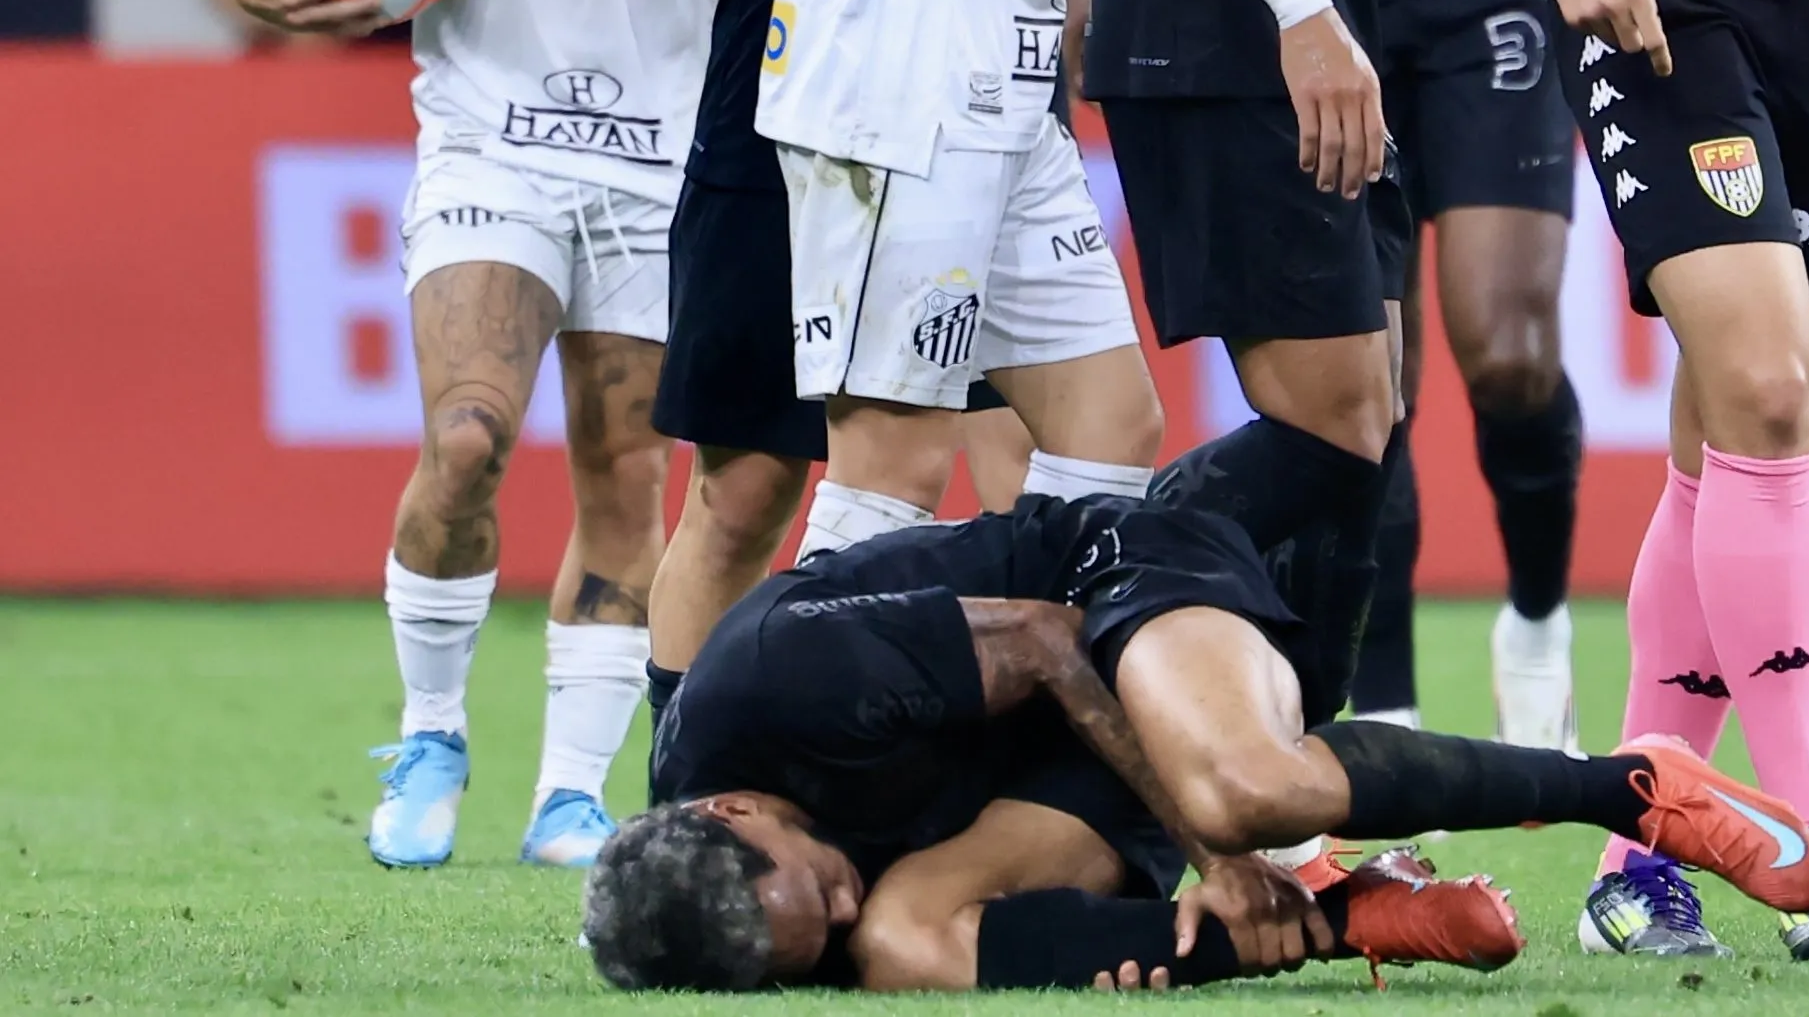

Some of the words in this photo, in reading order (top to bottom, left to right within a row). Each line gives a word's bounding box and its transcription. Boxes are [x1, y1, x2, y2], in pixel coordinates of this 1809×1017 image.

[567, 75, 595, 104] H
[502, 99, 662, 155] HAVAN
[1703, 144, 1746, 167] FPF
